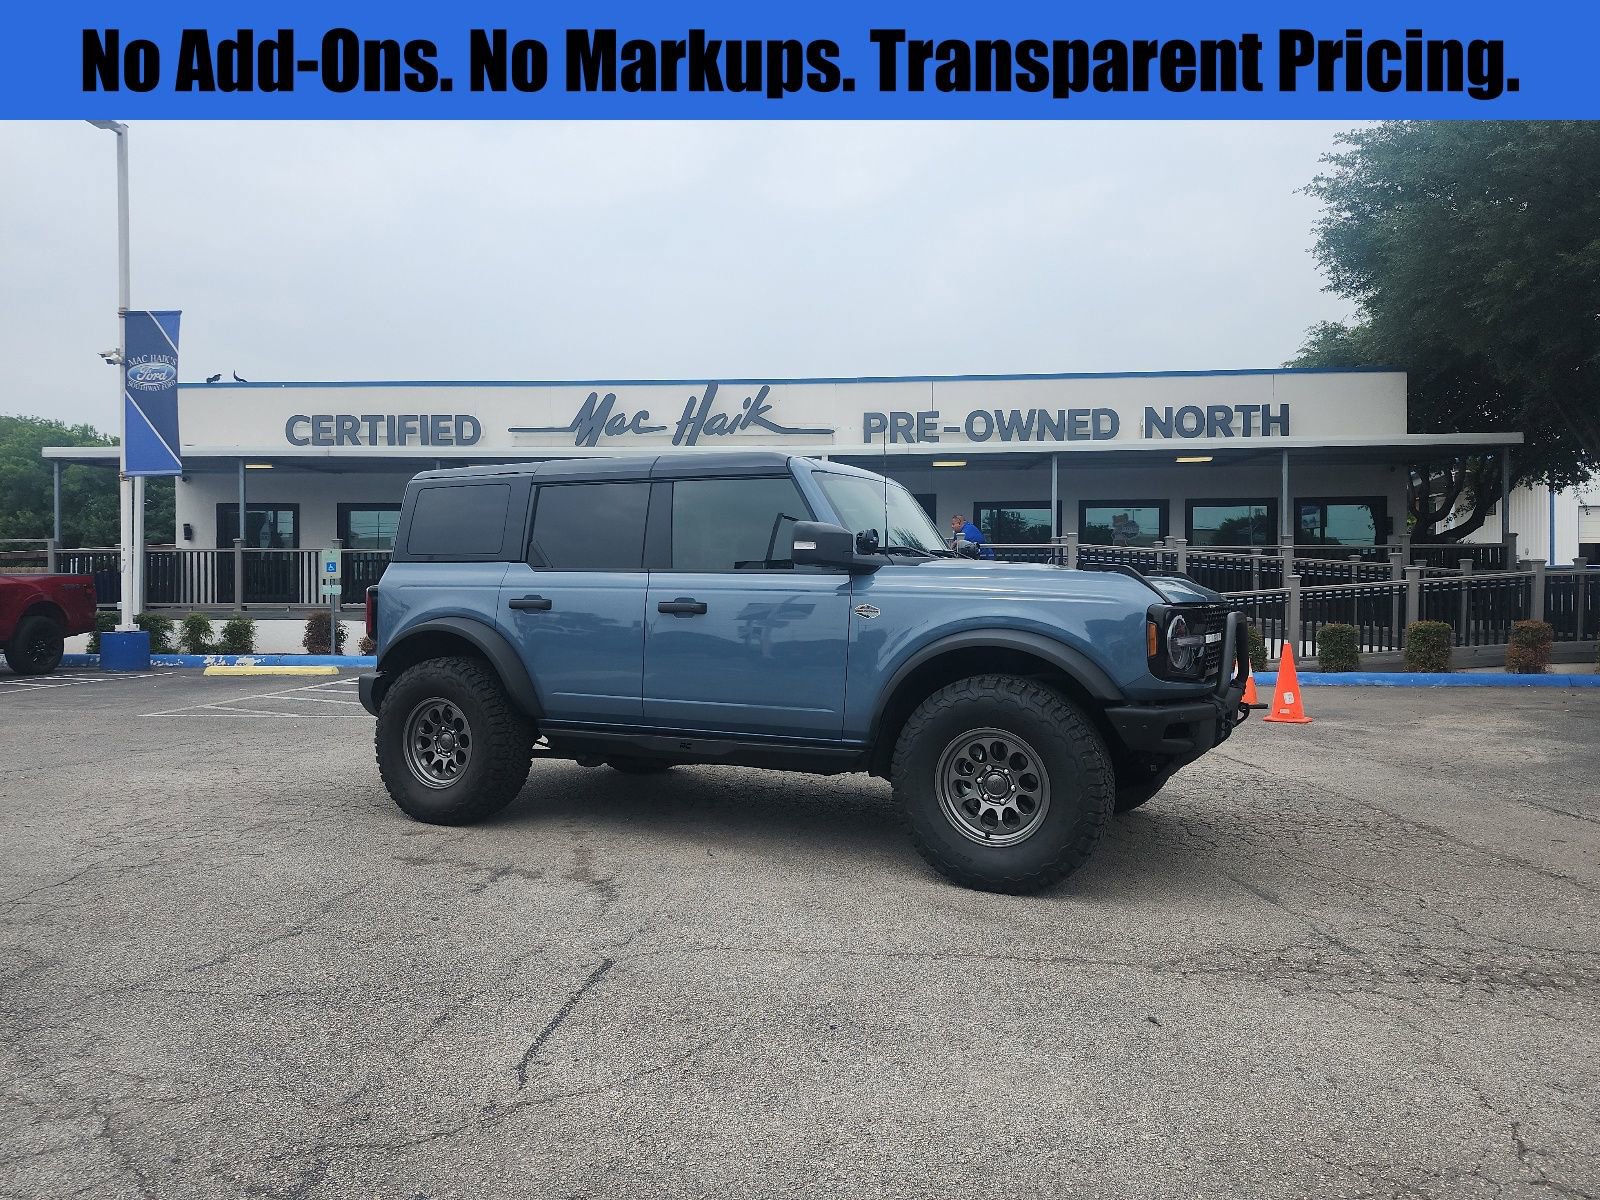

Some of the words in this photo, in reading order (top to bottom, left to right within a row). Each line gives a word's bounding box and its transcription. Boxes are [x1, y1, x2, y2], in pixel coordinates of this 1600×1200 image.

[136, 366, 168, 381] Ford
[285, 414, 481, 446] CERTIFIED
[570, 391, 667, 447] Mac
[672, 382, 786, 447] Haik
[863, 408, 1120, 442] PRE-OWNED
[1144, 403, 1290, 437] NORTH
